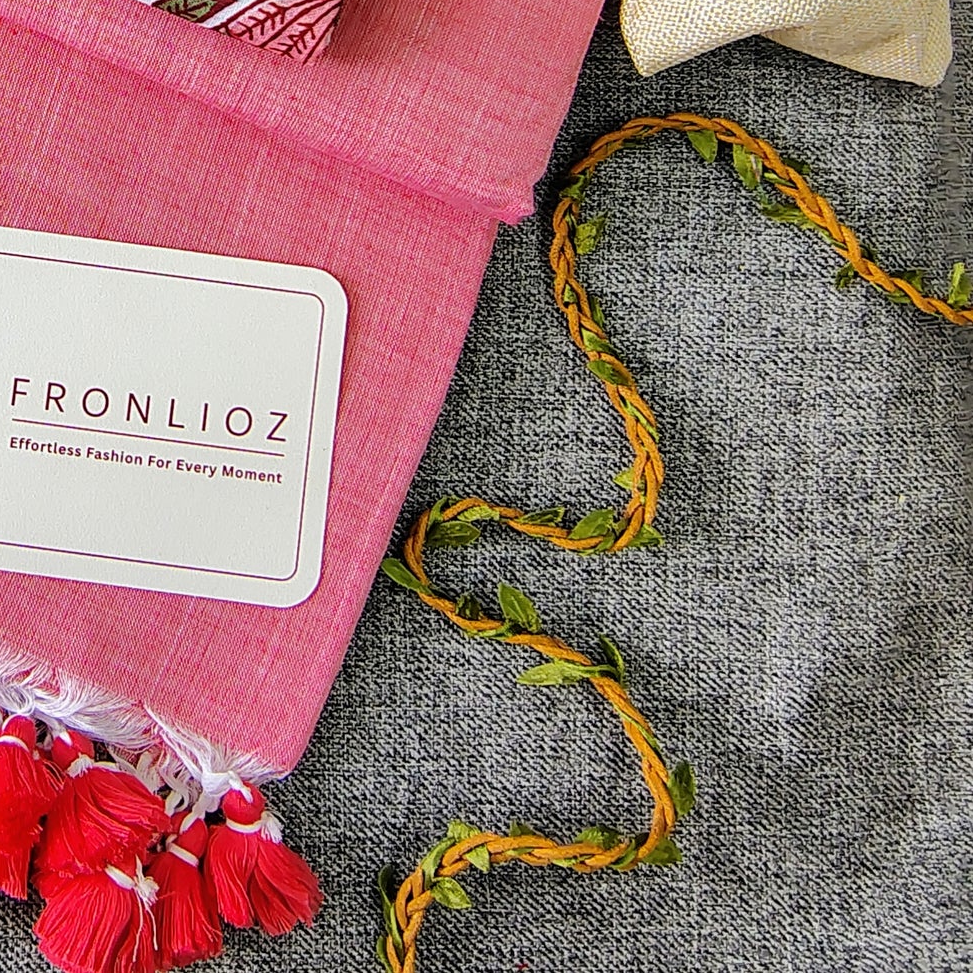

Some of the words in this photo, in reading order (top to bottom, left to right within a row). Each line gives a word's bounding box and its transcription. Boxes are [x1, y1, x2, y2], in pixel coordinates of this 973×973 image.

[10, 377, 288, 442] FRONLIOZ
[9, 437, 82, 458] Effortless
[86, 446, 144, 466] Fashion
[147, 455, 172, 469] For
[175, 459, 217, 478] Every
[221, 466, 283, 484] Moment
